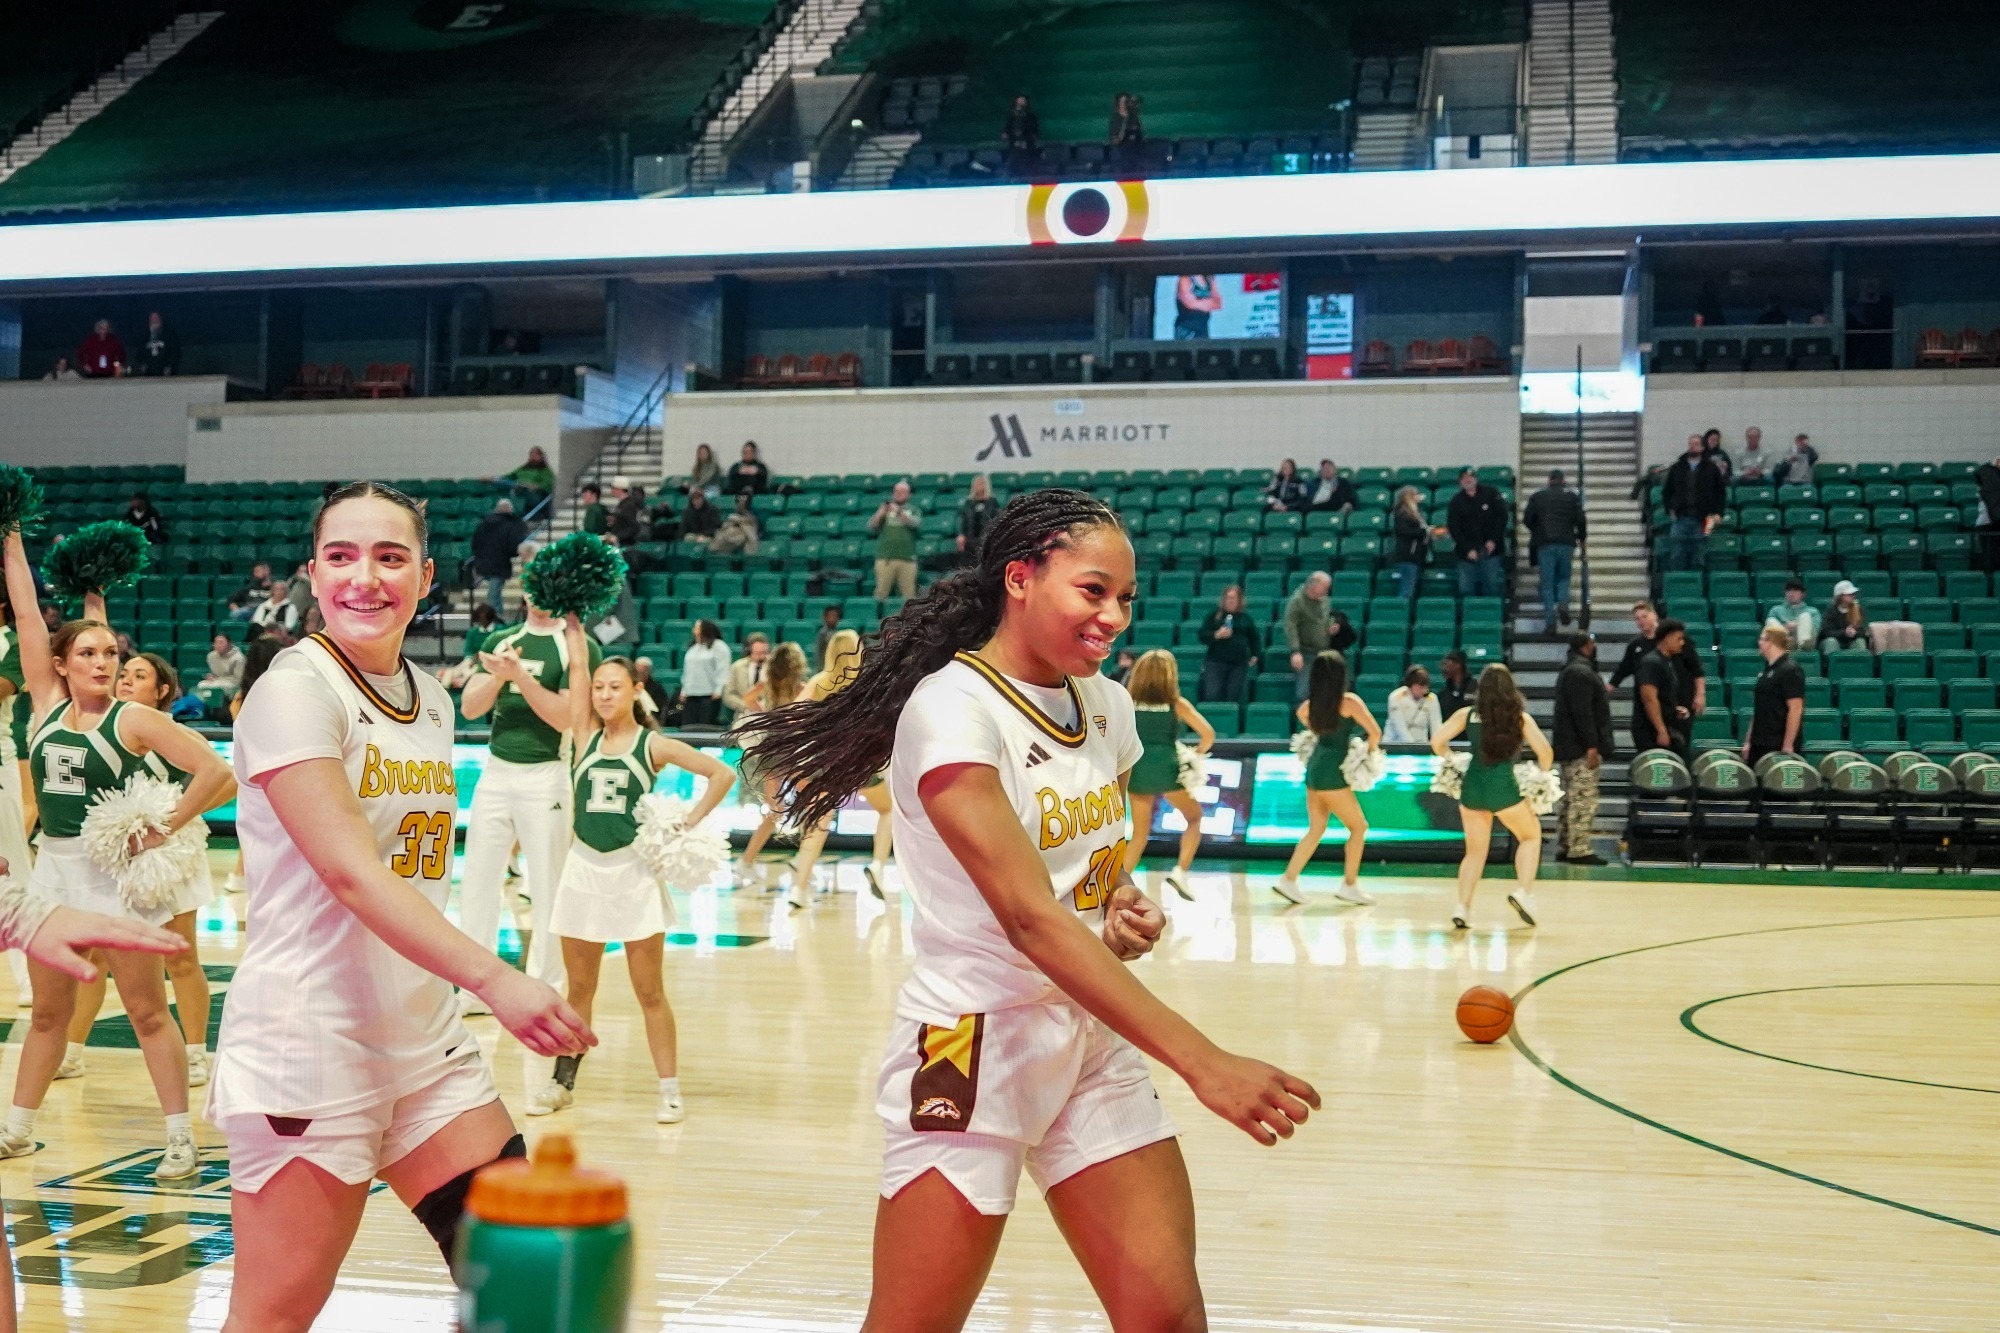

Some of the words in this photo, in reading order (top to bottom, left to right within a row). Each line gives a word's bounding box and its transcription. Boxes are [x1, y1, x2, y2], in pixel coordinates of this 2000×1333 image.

[1040, 423, 1171, 443] MARRIOTT
[41, 741, 89, 796] E
[358, 743, 458, 799] Bronc
[1651, 765, 1674, 788] E
[1715, 765, 1739, 789] E
[1781, 766, 1805, 789] E
[1850, 767, 1873, 791] E
[1915, 768, 1940, 792] E
[585, 767, 630, 815] E
[391, 811, 452, 881] 33
